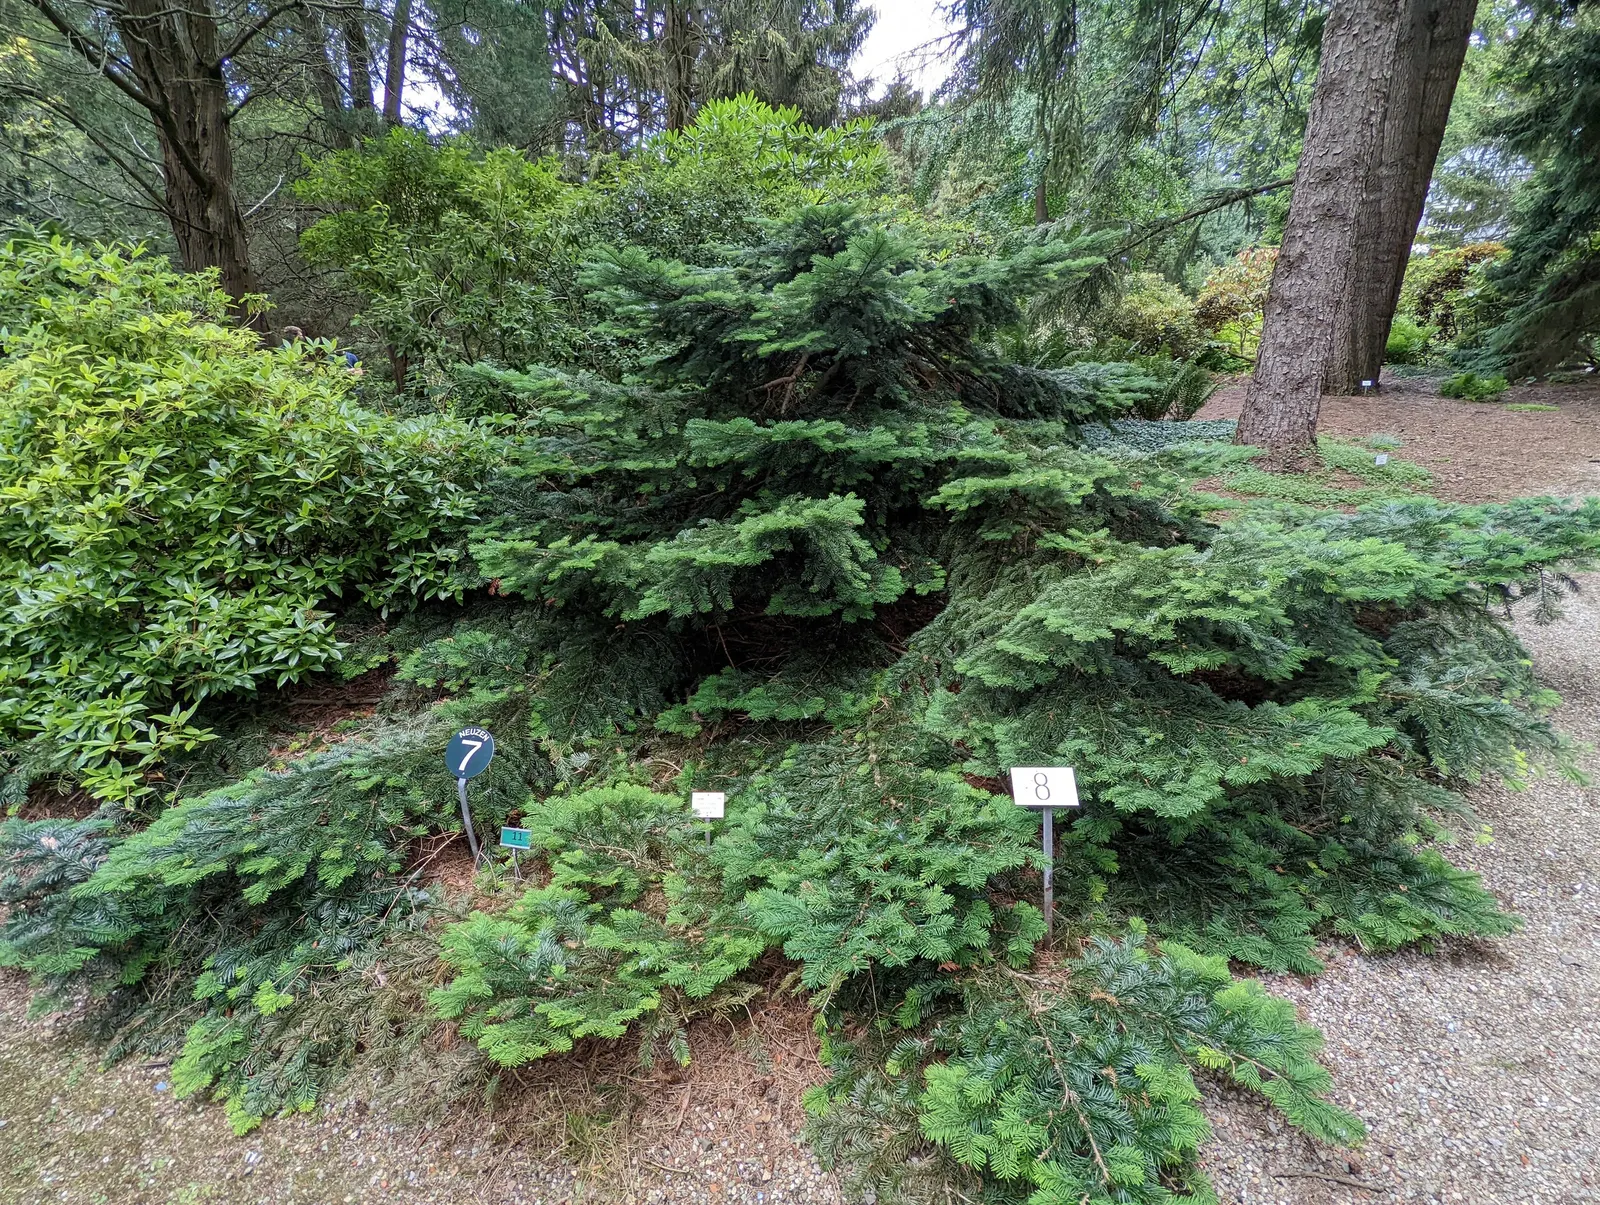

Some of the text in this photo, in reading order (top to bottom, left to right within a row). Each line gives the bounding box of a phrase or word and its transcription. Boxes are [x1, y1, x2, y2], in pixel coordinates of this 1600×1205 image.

[459, 728, 490, 741] NEUZEN
[458, 739, 482, 771] 7
[1033, 772, 1051, 801] 8
[512, 831, 522, 841] 11
